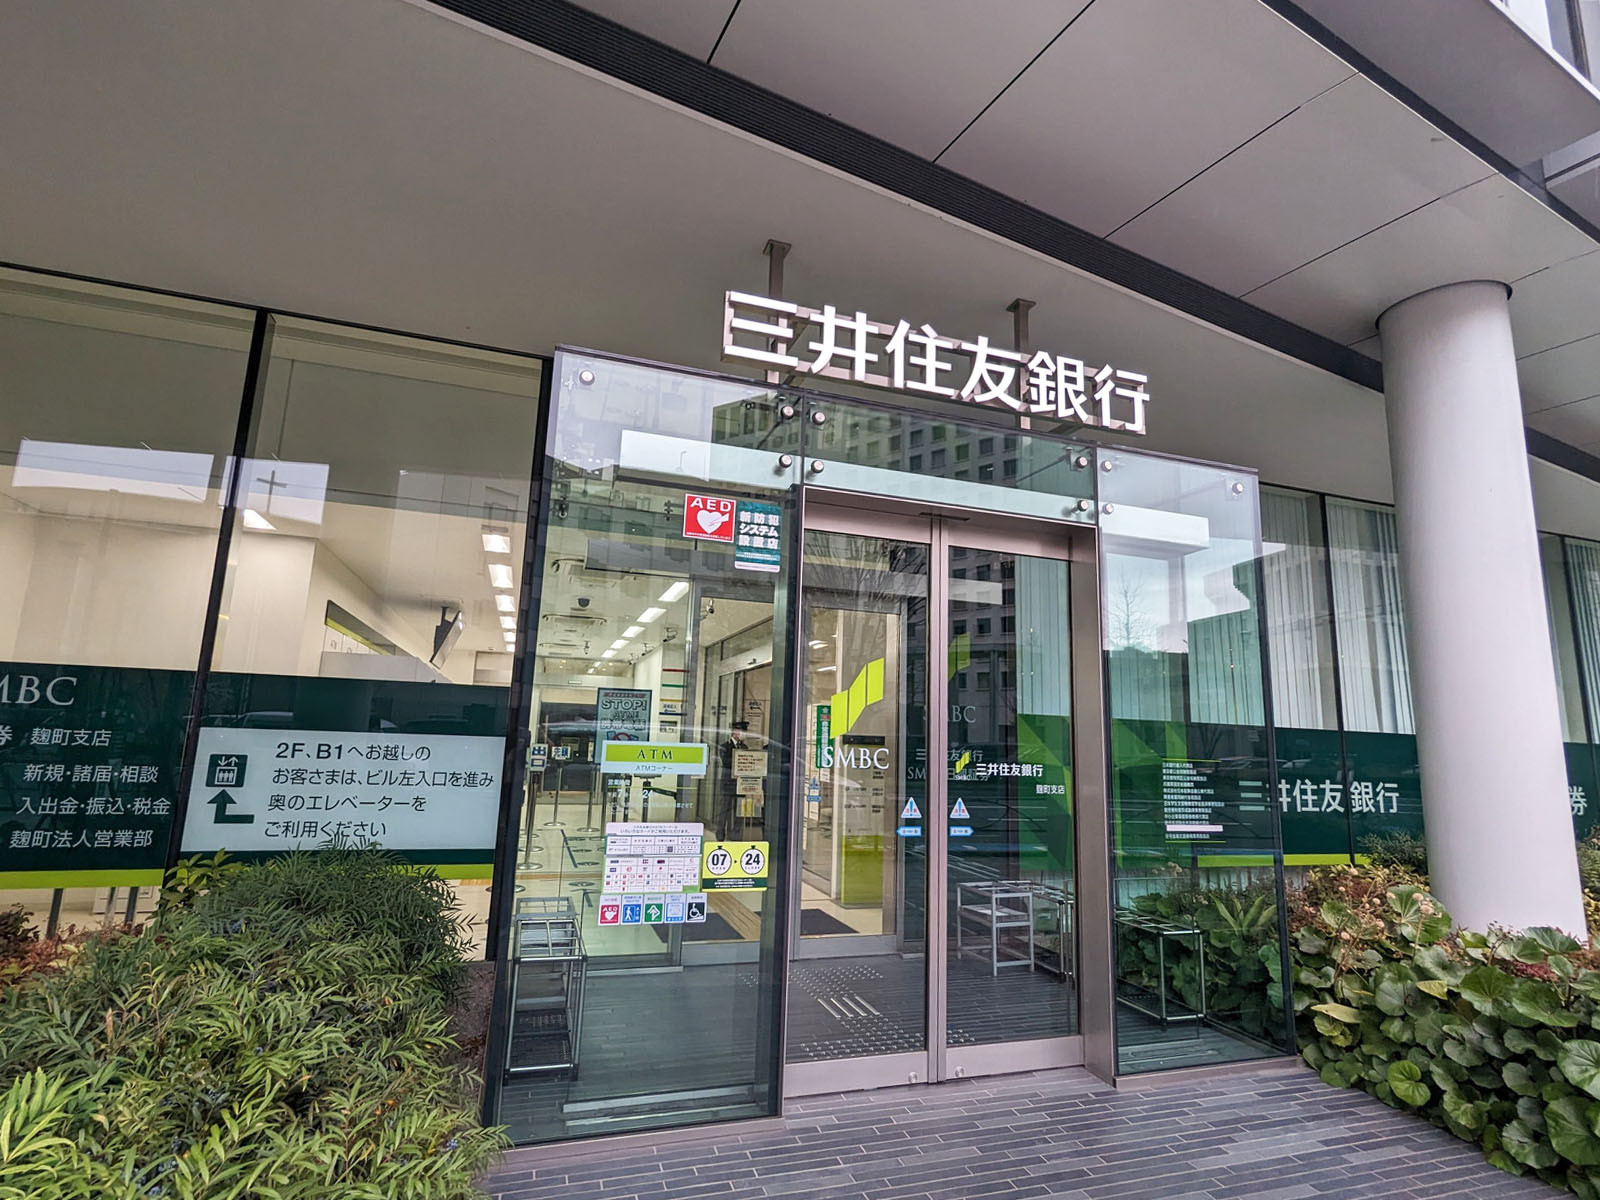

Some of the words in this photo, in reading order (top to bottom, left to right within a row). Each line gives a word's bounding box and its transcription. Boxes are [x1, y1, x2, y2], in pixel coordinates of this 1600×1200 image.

[724, 291, 1150, 432] 三井住友銀行
[690, 497, 731, 512] AED
[739, 523, 779, 537] システム
[601, 698, 648, 710] STOP!
[30, 728, 112, 746] 麹町支店
[275, 742, 431, 761] 2F、B1へお越しの
[637, 749, 674, 760] ATM
[823, 746, 890, 769] SMBC
[272, 768, 495, 788] お客さまは、ビル左入口を進み
[976, 763, 1044, 777] 三井住友銀行
[267, 794, 427, 812] 奥のエレベーターを
[1568, 785, 1588, 816] 券
[264, 820, 386, 838] ご利用ください
[9, 829, 153, 849] 麹町法人営業部
[711, 853, 728, 866] 07
[745, 853, 761, 866] 24
